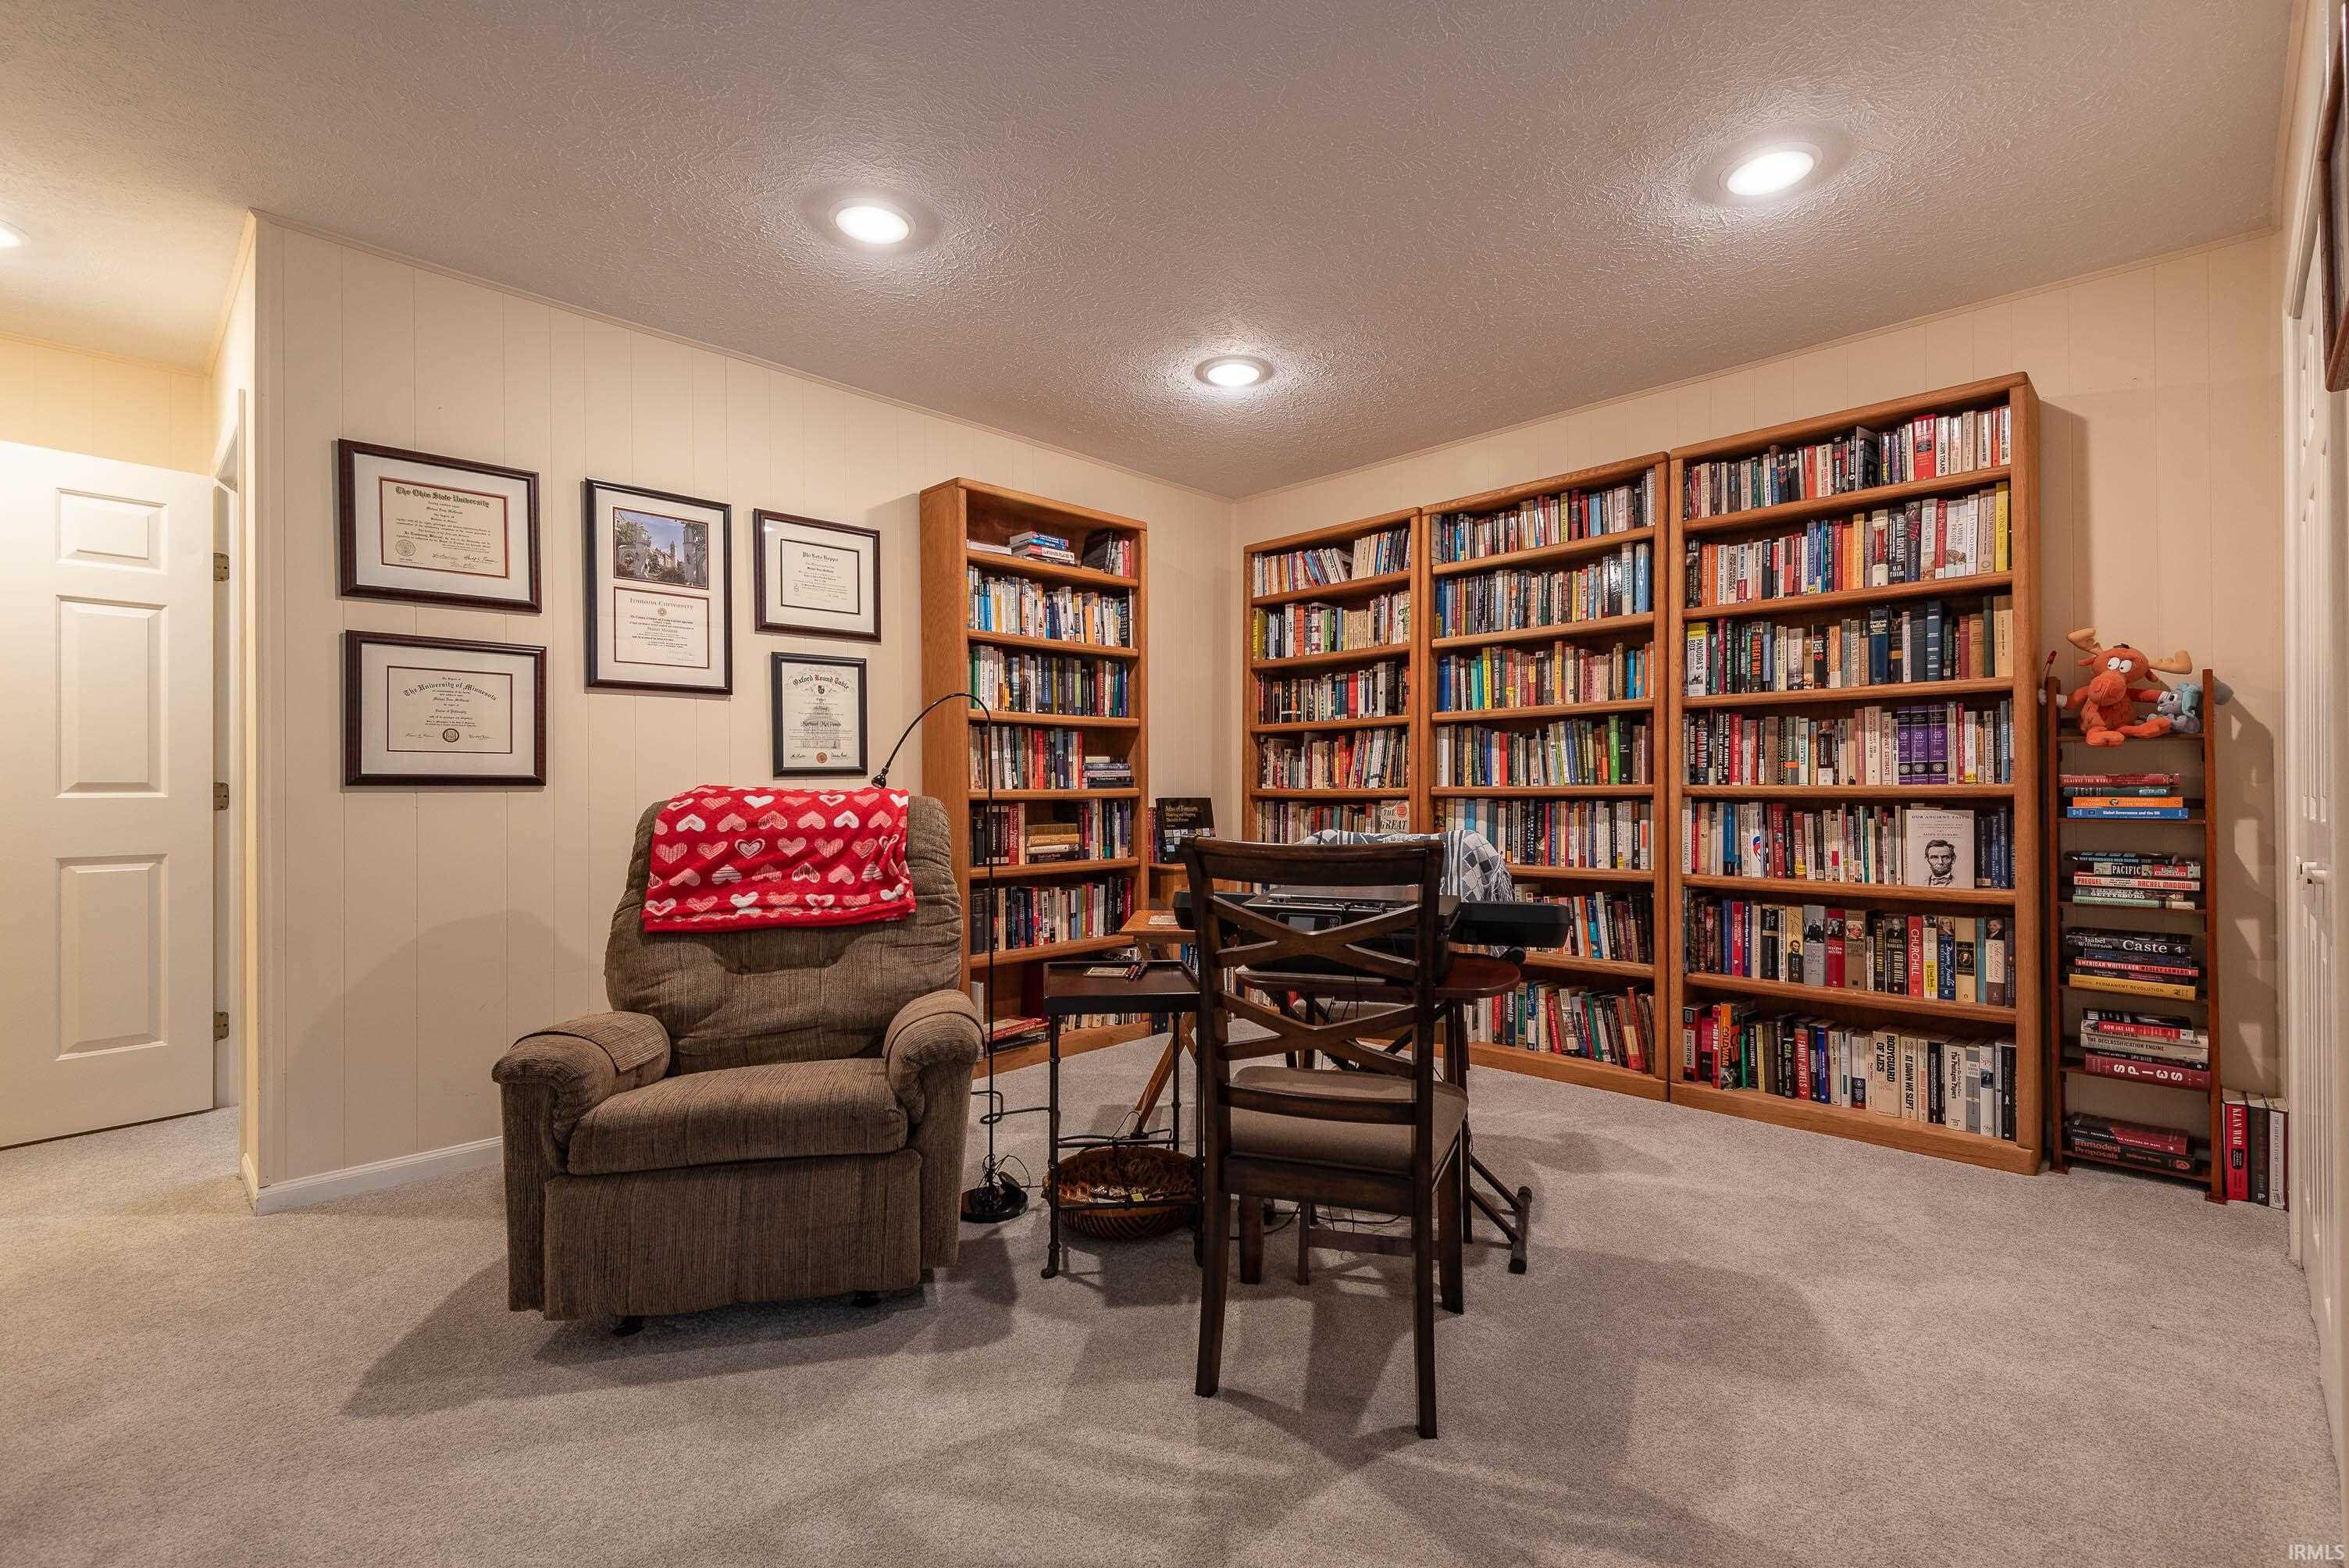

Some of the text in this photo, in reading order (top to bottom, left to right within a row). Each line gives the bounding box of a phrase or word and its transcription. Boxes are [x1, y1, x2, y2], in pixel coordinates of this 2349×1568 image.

[395, 486, 412, 495] The
[412, 489, 431, 499] Ohio
[432, 492, 451, 501] State
[453, 495, 490, 508] University
[1896, 515, 1905, 536] AMERICAN
[1752, 640, 1760, 675] GREAT WAR
[793, 675, 813, 686] Oxford
[834, 677, 850, 690] Table
[418, 681, 454, 691] University
[465, 684, 497, 701] Minnesota
[1697, 731, 1707, 768] COLD WAR
[2112, 865, 2141, 875] PACIFIC
[1911, 928, 1919, 976] CHURCHILL
[2123, 940, 2168, 953] Caste
[1894, 951, 1904, 983] CHURCHILL
[1877, 1042, 1884, 1053] OF
[2098, 1038, 2144, 1048] DECLASSIFICATION
[1886, 1035, 1895, 1083] BODYGUARD
[1905, 1054, 1912, 1063] AT
[1798, 1063, 1807, 1088] JEWELS
[2114, 1064, 2183, 1081] SPIES
[1905, 1082, 1912, 1093] WE
[2233, 1129, 2242, 1145] WAR
[2075, 1140, 2120, 1153] Immodest
[2075, 1147, 2118, 1160] Proposals
